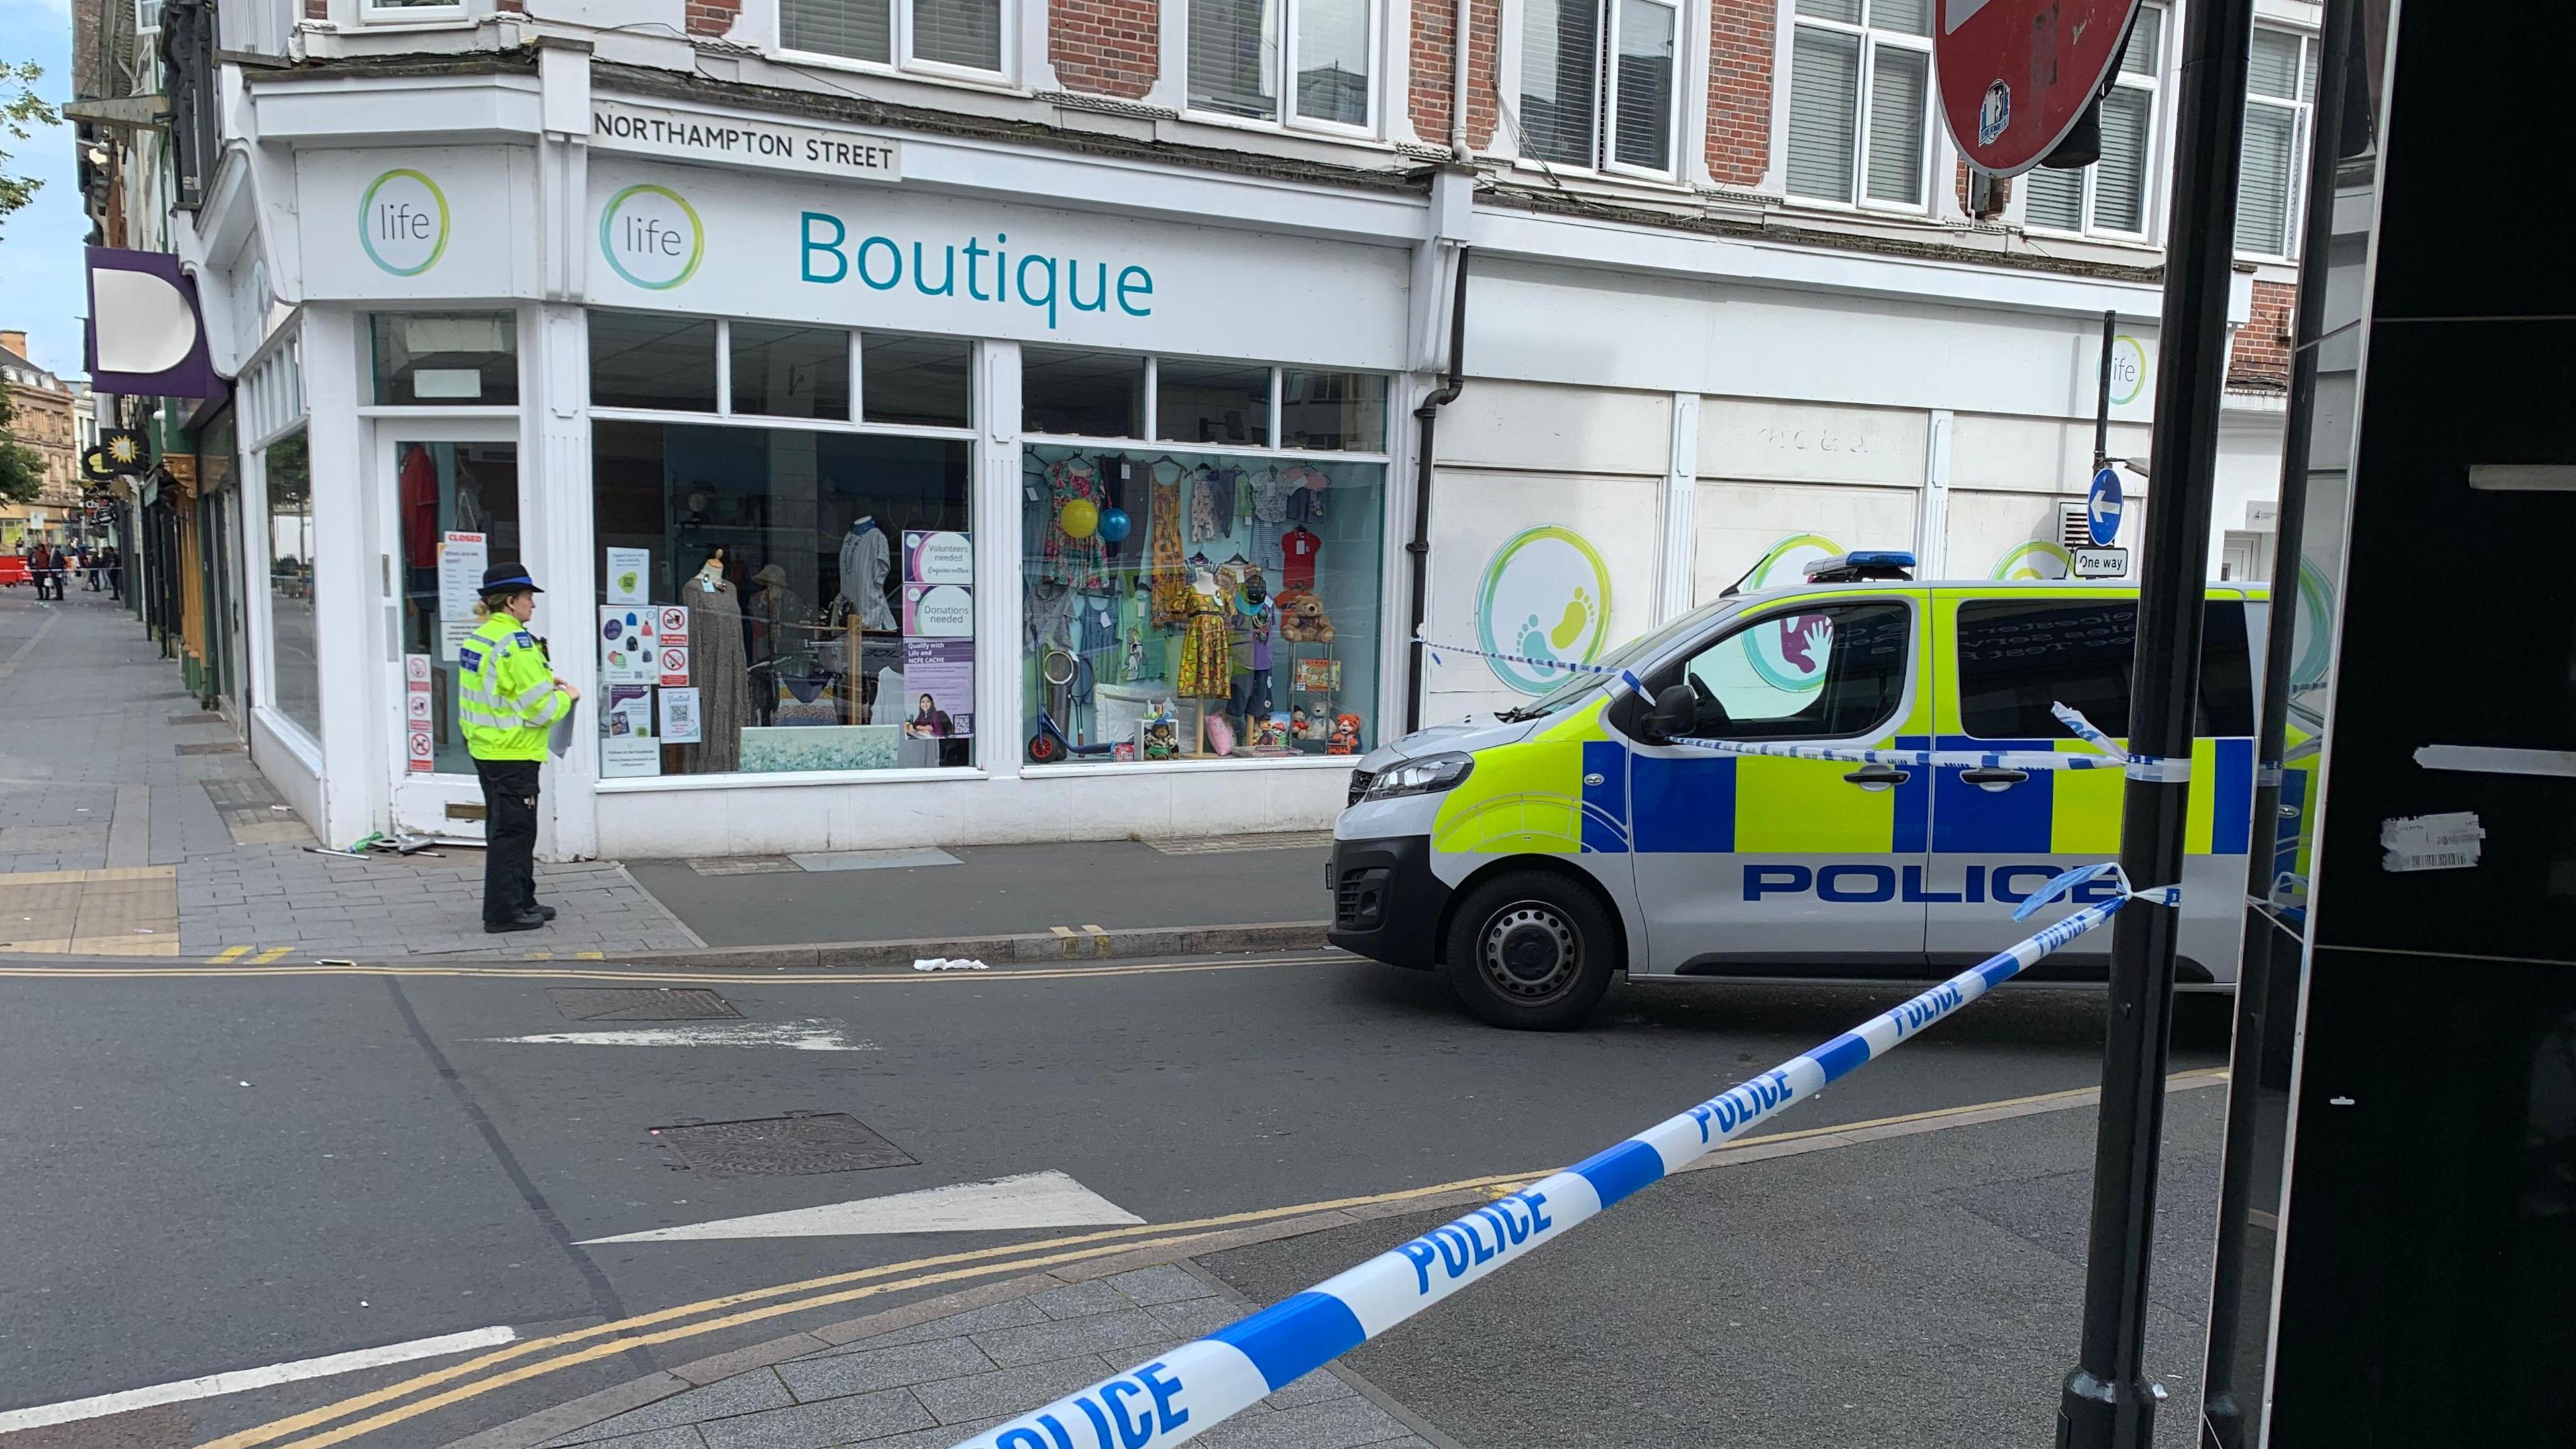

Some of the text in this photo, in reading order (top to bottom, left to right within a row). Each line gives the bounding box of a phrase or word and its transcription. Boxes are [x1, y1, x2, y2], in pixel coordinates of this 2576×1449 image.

[594, 112, 894, 170] NORTHAMPTON STREET
[380, 204, 430, 241] life
[626, 215, 682, 256] life
[801, 211, 1154, 330] Boutique
[2113, 357, 2135, 382] ife
[449, 534, 482, 543] CLOSED
[928, 544, 969, 553] Volunteers
[2080, 555, 2123, 571] One way
[924, 605, 969, 614] Donations
[930, 614, 964, 623] needed
[908, 642, 930, 650] Qualify
[1743, 864, 2117, 904] POLICE
[1886, 981, 1964, 1037] POLICE
[1684, 1069, 1793, 1144] POLICE
[1394, 1189, 1552, 1296] POLICE
